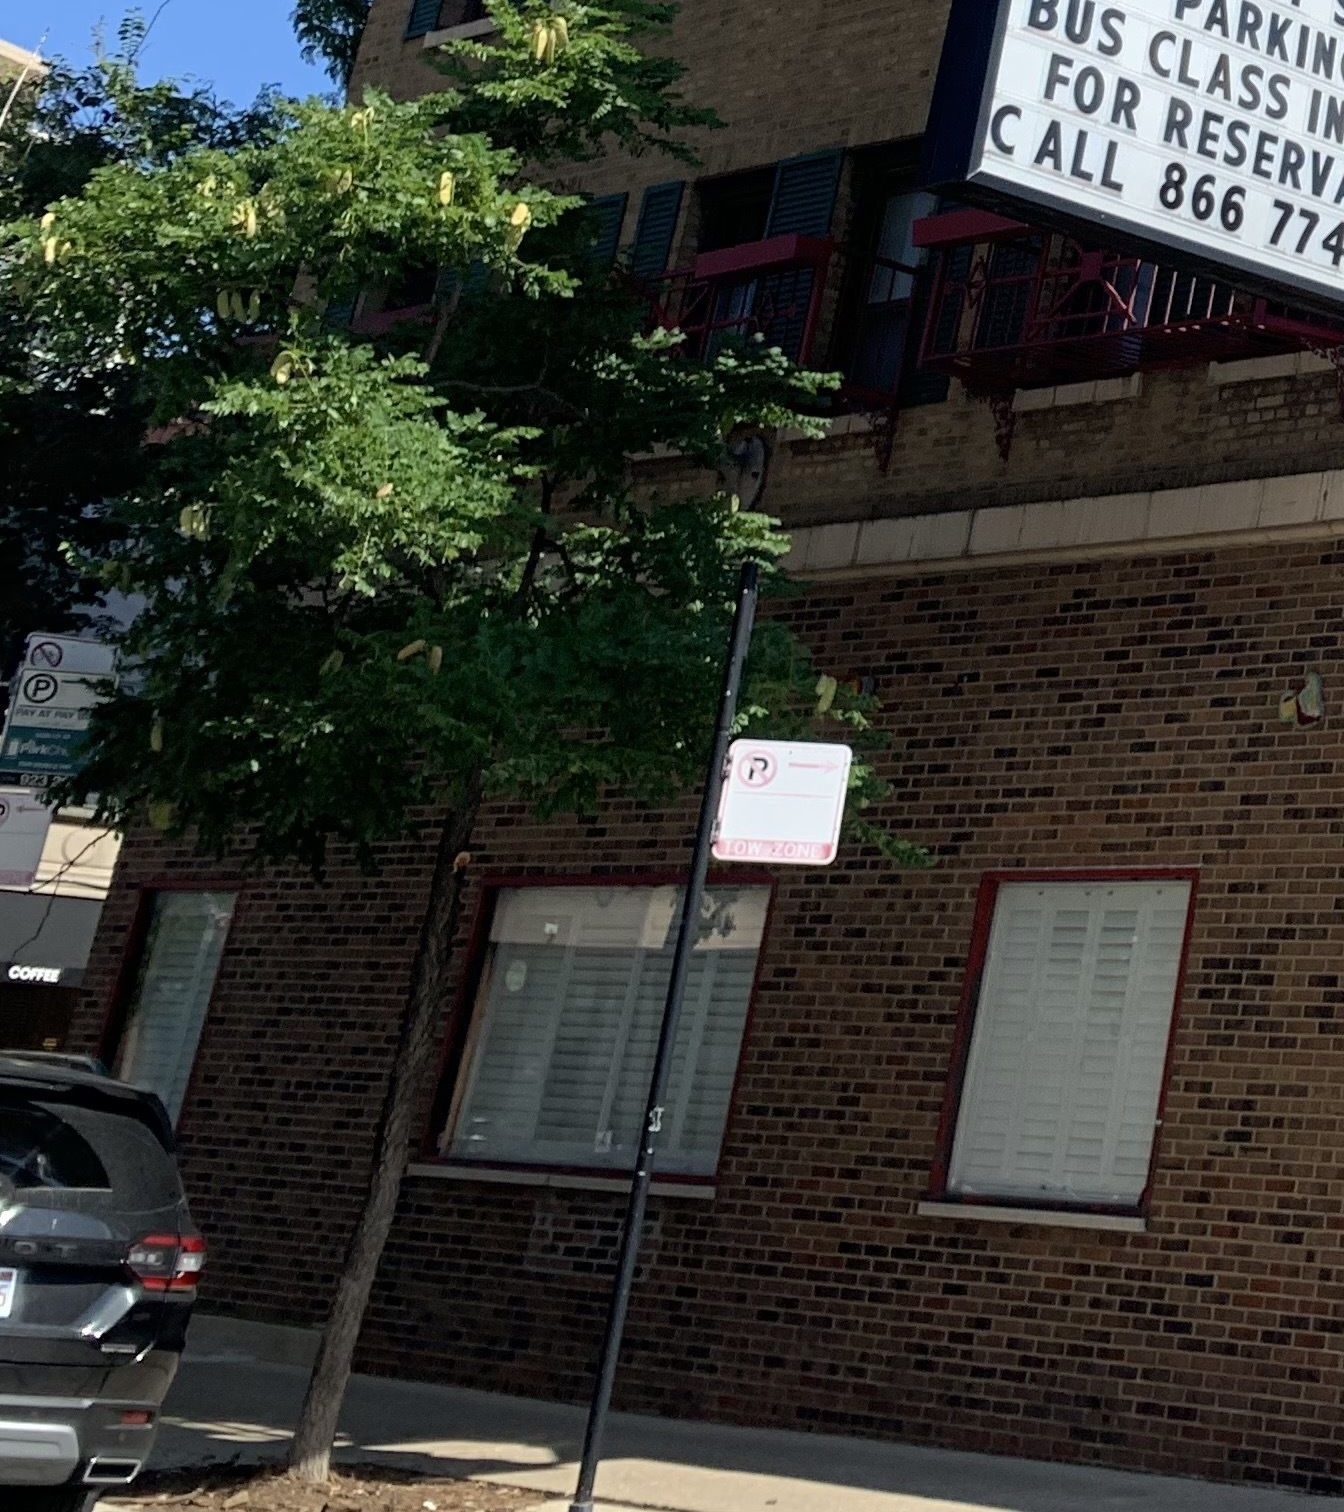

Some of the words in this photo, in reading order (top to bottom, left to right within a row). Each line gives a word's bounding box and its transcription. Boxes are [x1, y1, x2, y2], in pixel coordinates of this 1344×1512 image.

[1043, 54, 1141, 131] FOR
[1149, 31, 1291, 120] CLASS
[1159, 162, 1246, 232] 866
[724, 840, 762, 857] TOW
[771, 842, 822, 859] ZONE
[8, 964, 62, 983] COFFEE
